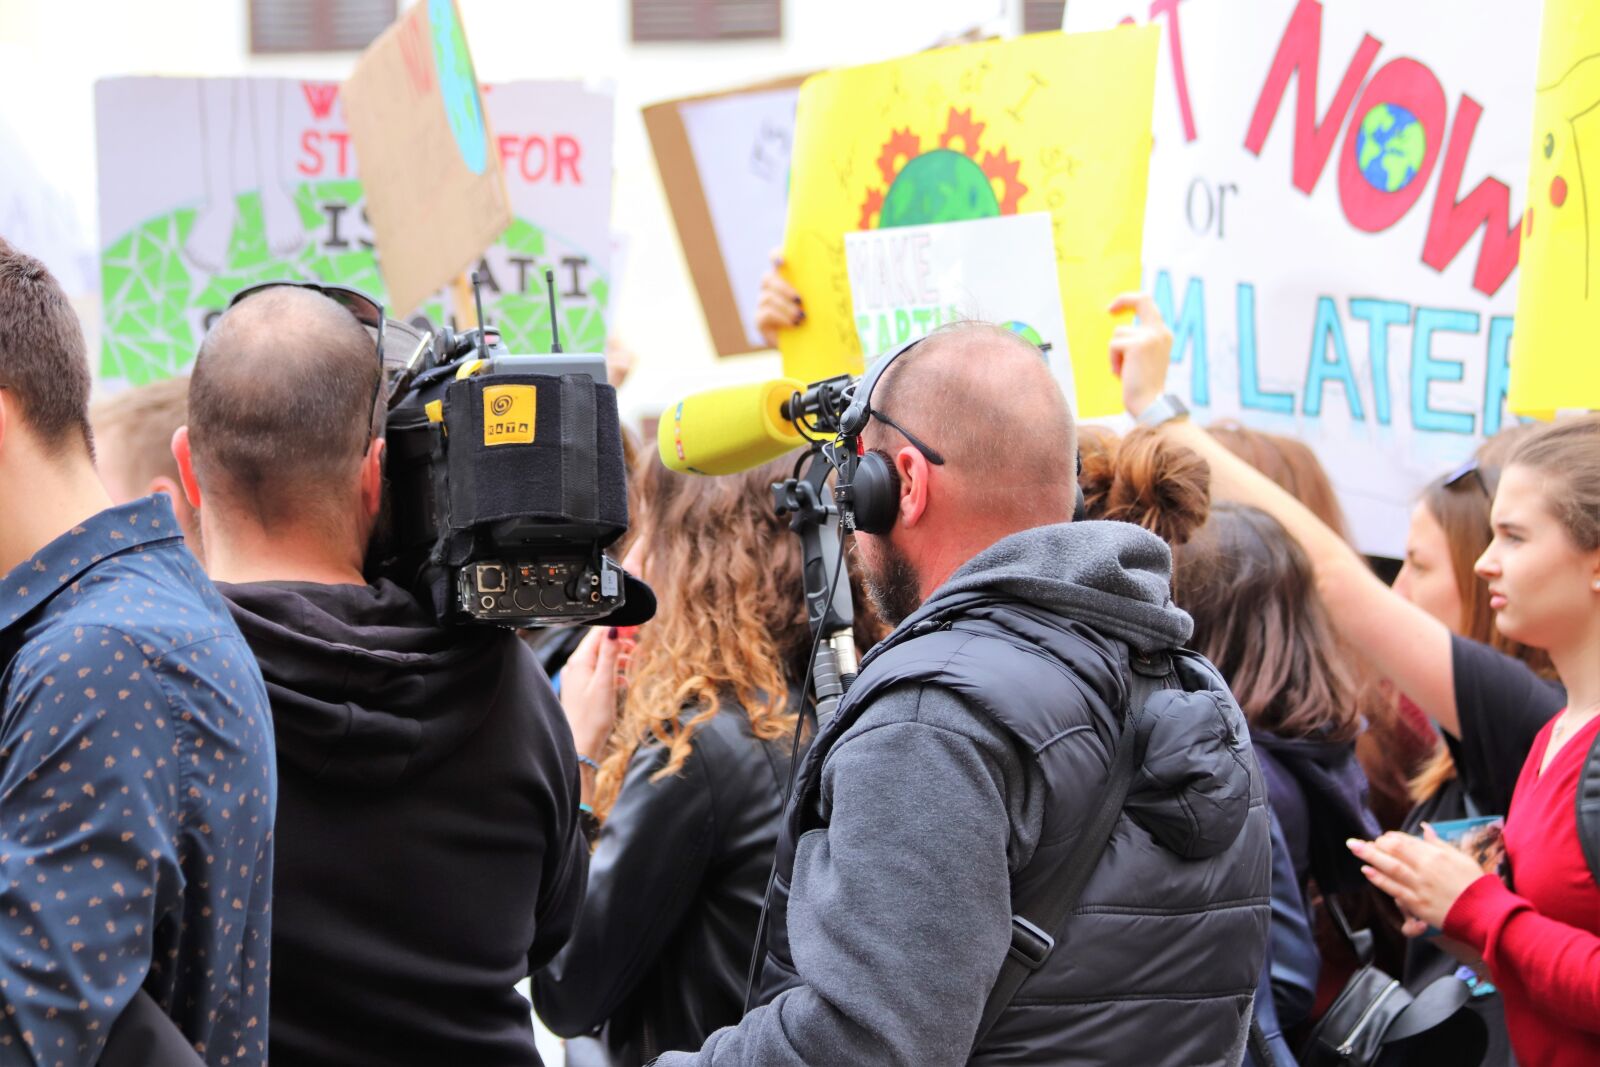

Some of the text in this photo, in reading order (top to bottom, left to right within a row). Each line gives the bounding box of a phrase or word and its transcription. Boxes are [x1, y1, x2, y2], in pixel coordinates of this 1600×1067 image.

[499, 134, 583, 184] FOR
[1243, 0, 1522, 299] NOW
[1185, 176, 1240, 240] or
[561, 256, 588, 297] I
[847, 232, 941, 312] MAKE
